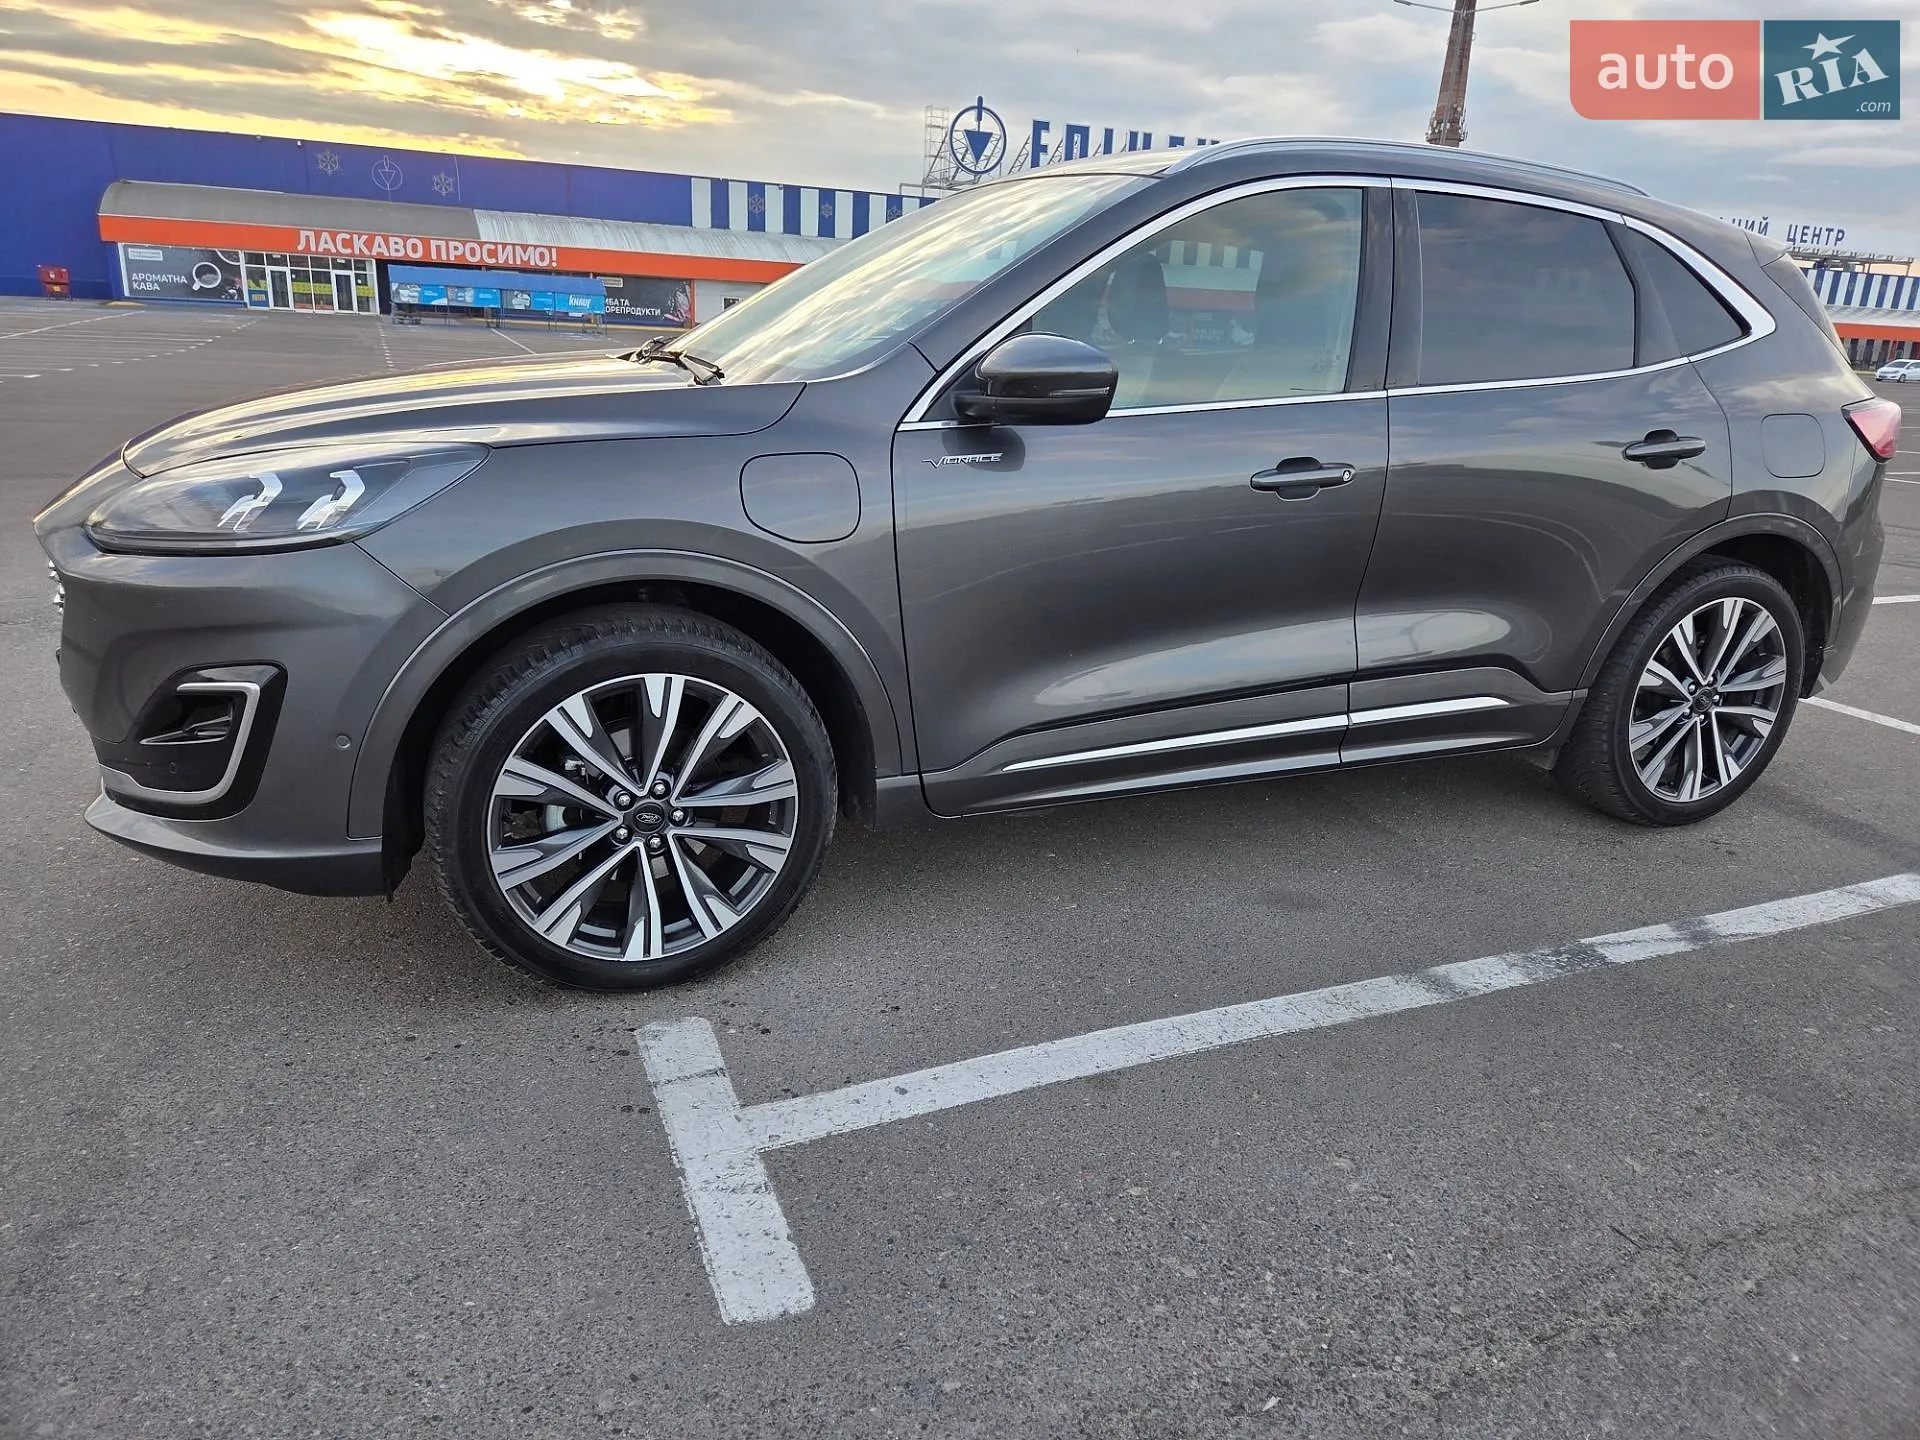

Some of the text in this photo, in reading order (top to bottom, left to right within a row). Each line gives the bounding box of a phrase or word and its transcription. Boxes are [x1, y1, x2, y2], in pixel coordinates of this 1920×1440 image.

[1786, 223, 1846, 247] ЦЕНТР
[297, 230, 558, 267] ЛАСКАВО ПРОСИМО!
[131, 272, 188, 284] АРОМАТНА
[132, 281, 160, 291] КАВА
[620, 298, 630, 307] ТА
[605, 305, 661, 316] ОРЕПРОДУКТИ
